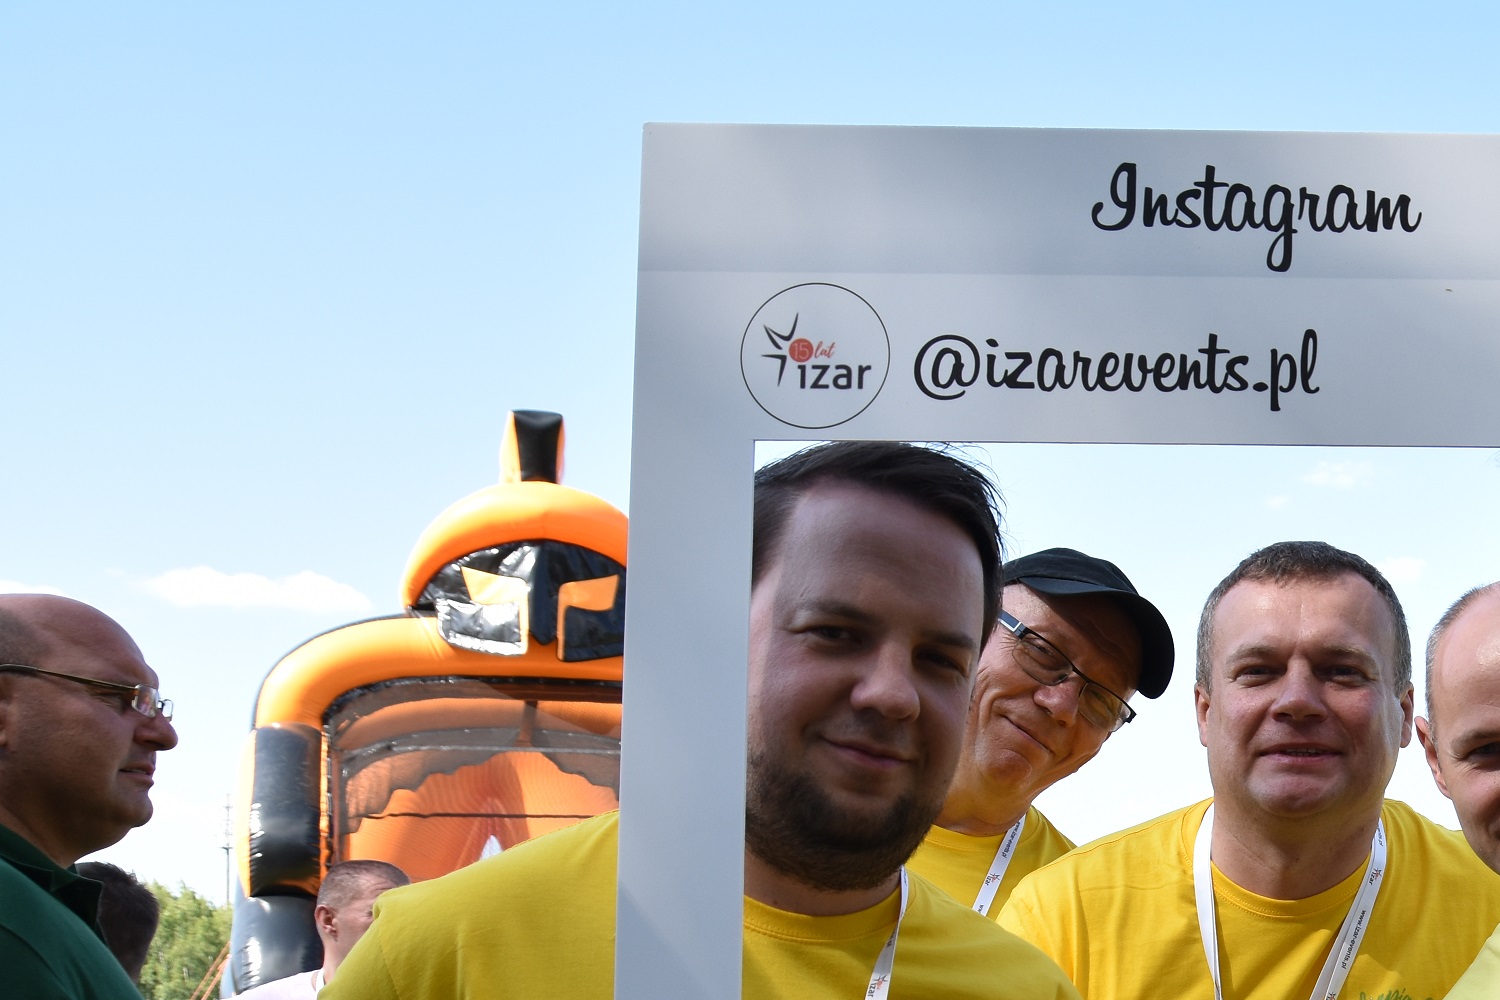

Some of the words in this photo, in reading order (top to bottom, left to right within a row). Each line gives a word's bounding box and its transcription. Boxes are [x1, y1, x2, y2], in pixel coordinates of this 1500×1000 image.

[1091, 161, 1422, 273] Instagram
[793, 341, 810, 362] 15
[814, 340, 836, 359] lat
[797, 364, 872, 390] izar
[914, 328, 1321, 413] @izarevents.pl
[1340, 909, 1367, 970] www.izar-events.pl
